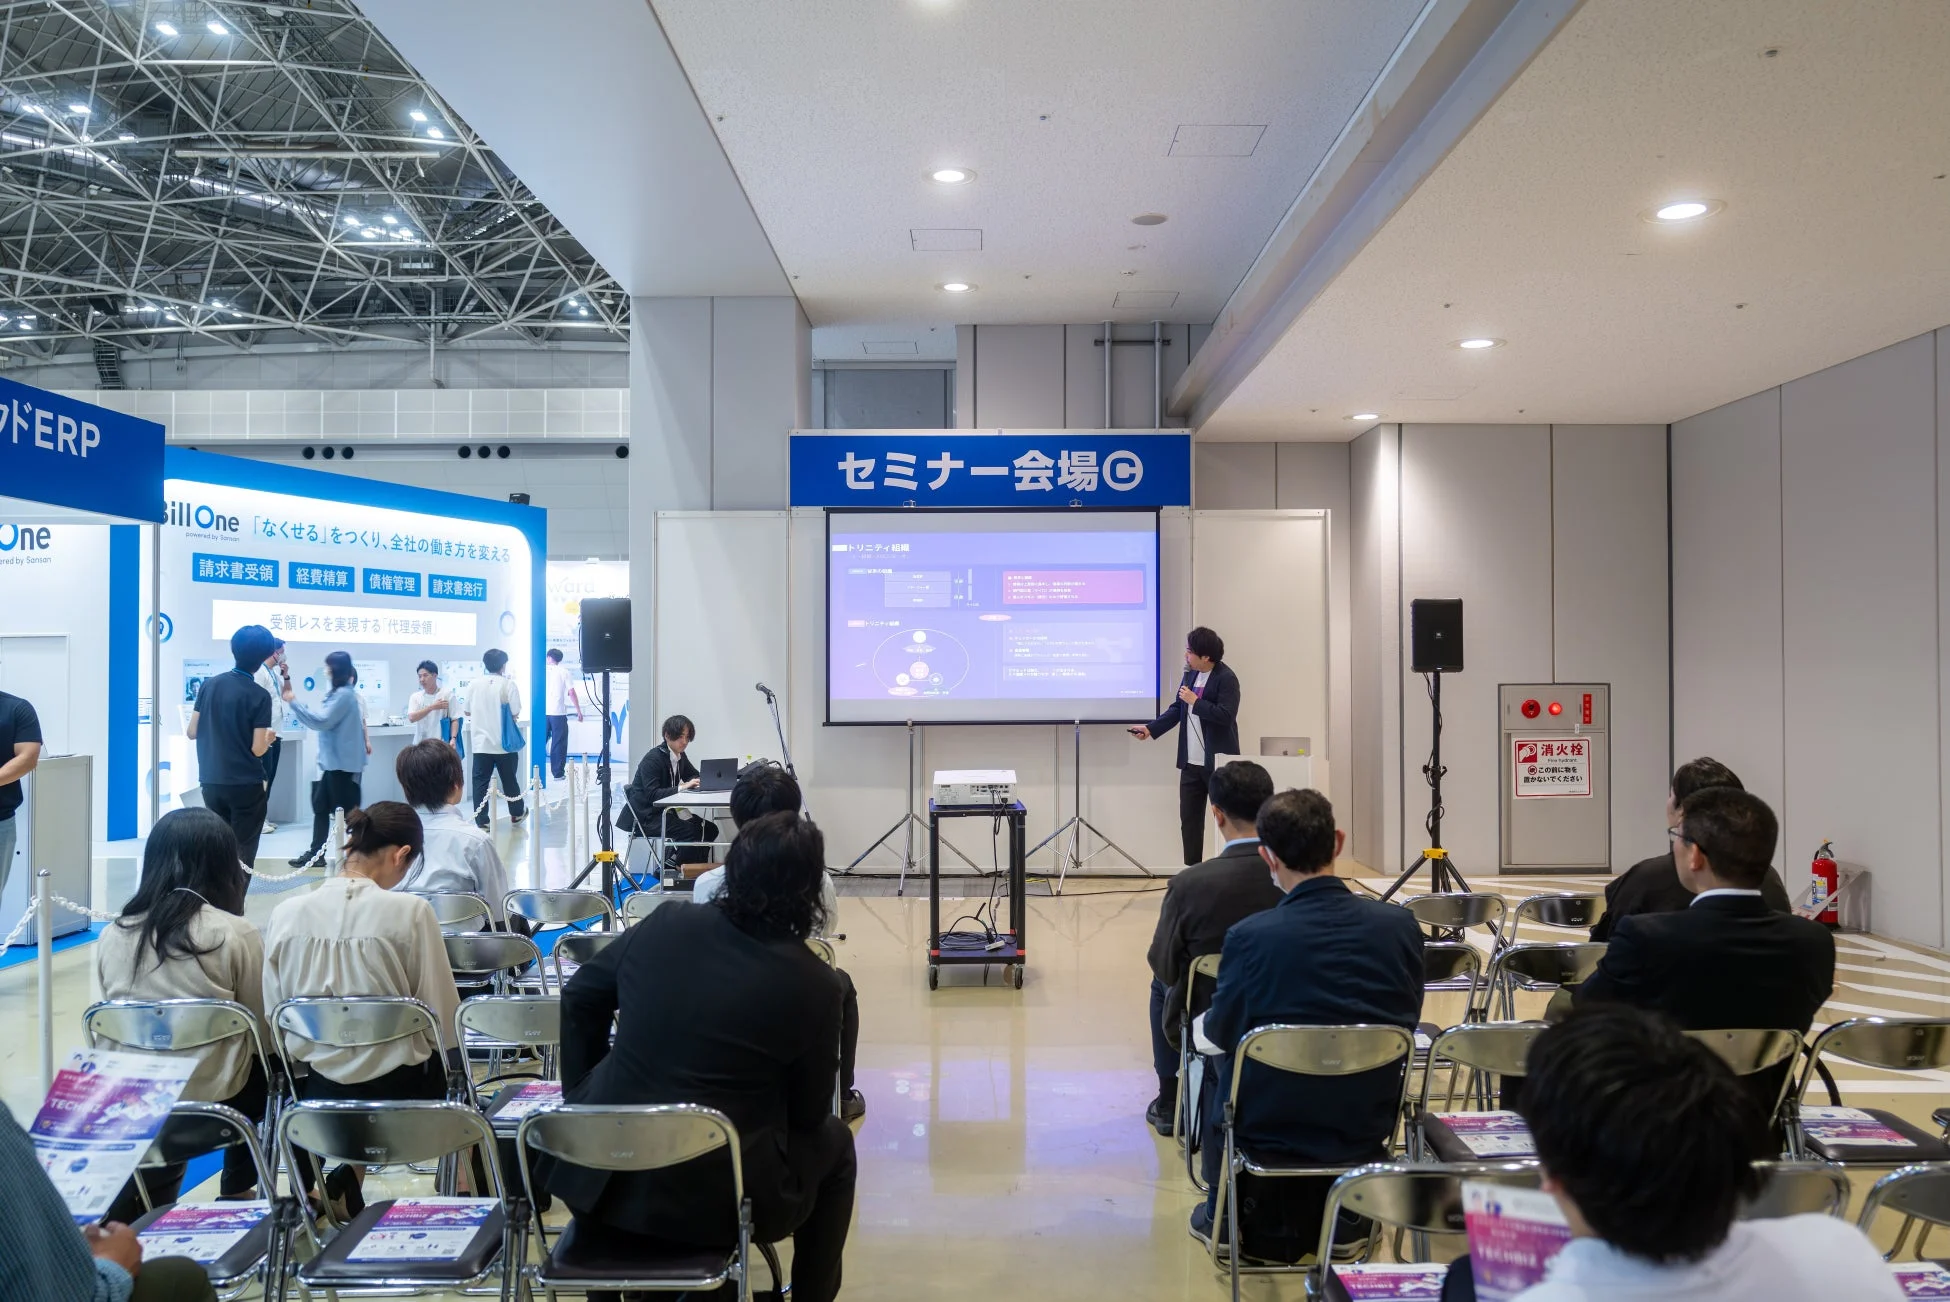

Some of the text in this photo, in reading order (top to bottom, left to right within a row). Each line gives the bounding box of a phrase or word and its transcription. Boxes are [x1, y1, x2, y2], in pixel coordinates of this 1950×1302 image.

[195, 505, 240, 533] One
[15, 556, 24, 566] by
[26, 555, 52, 564] Sansan
[198, 558, 275, 583] 請求書受領
[296, 567, 348, 587] 経費精算
[369, 573, 416, 592] 債権管理
[433, 578, 483, 598] 請求書発行
[270, 613, 438, 636] 受領レスを実現する「代理受領」
[1541, 743, 1584, 757] 消火栓
[1538, 766, 1578, 774] この前に物を
[50, 1098, 102, 1114] TECHZ
